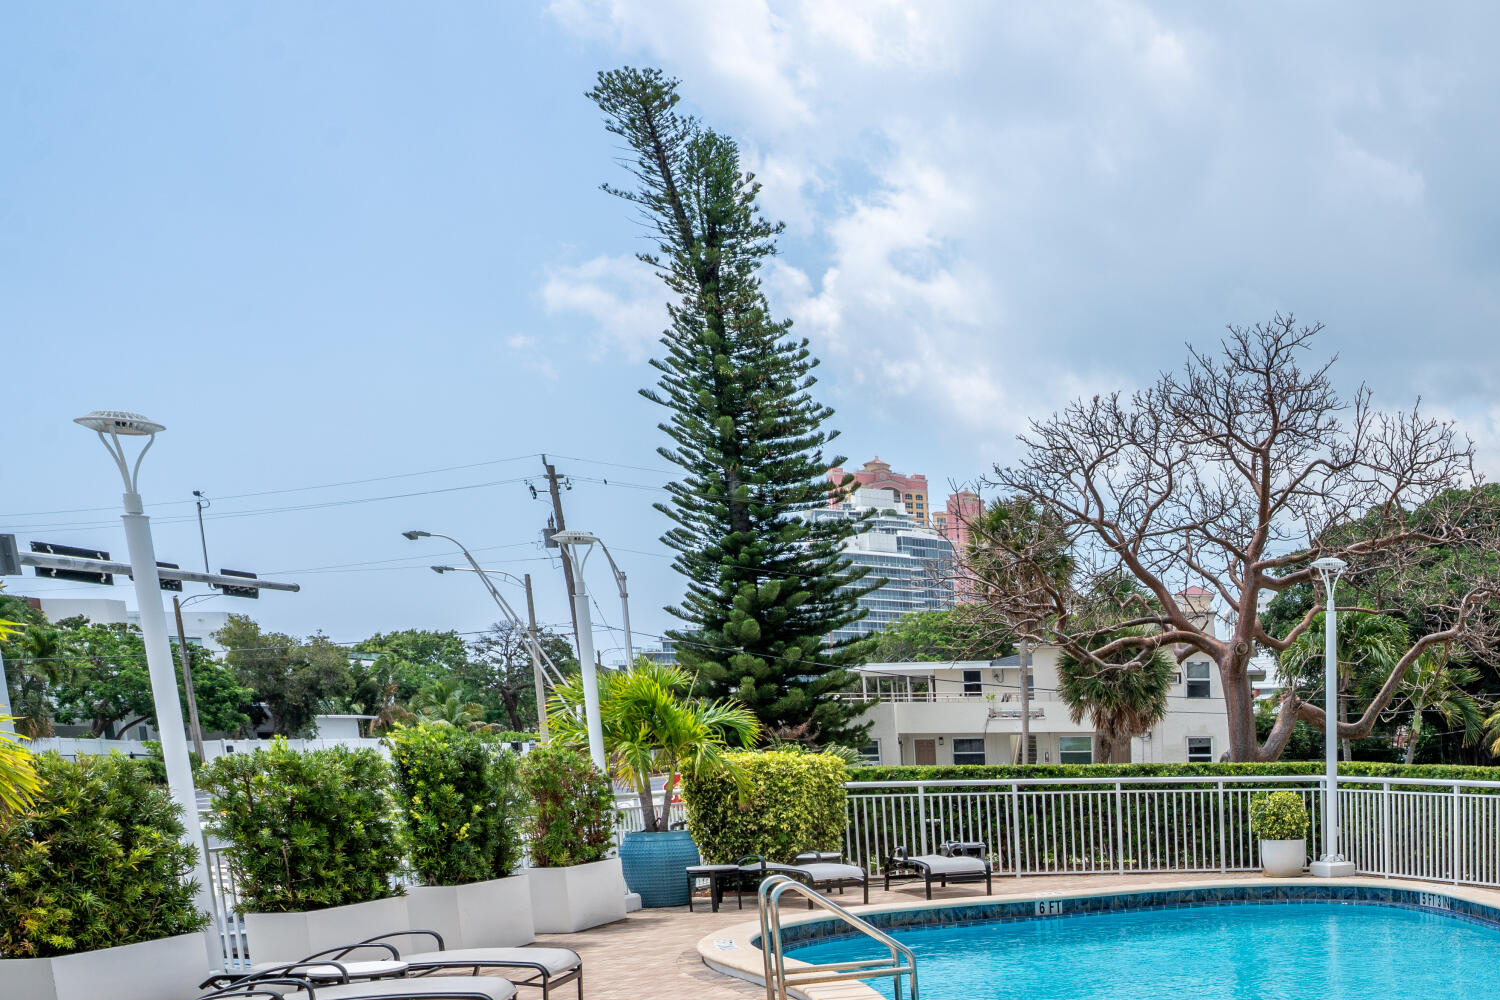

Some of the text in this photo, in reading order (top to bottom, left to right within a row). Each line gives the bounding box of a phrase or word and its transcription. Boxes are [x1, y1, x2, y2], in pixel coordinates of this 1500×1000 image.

[1040, 900, 1062, 914] 6 FT
[1428, 894, 1436, 906] FT
[1443, 896, 1450, 909] IN
